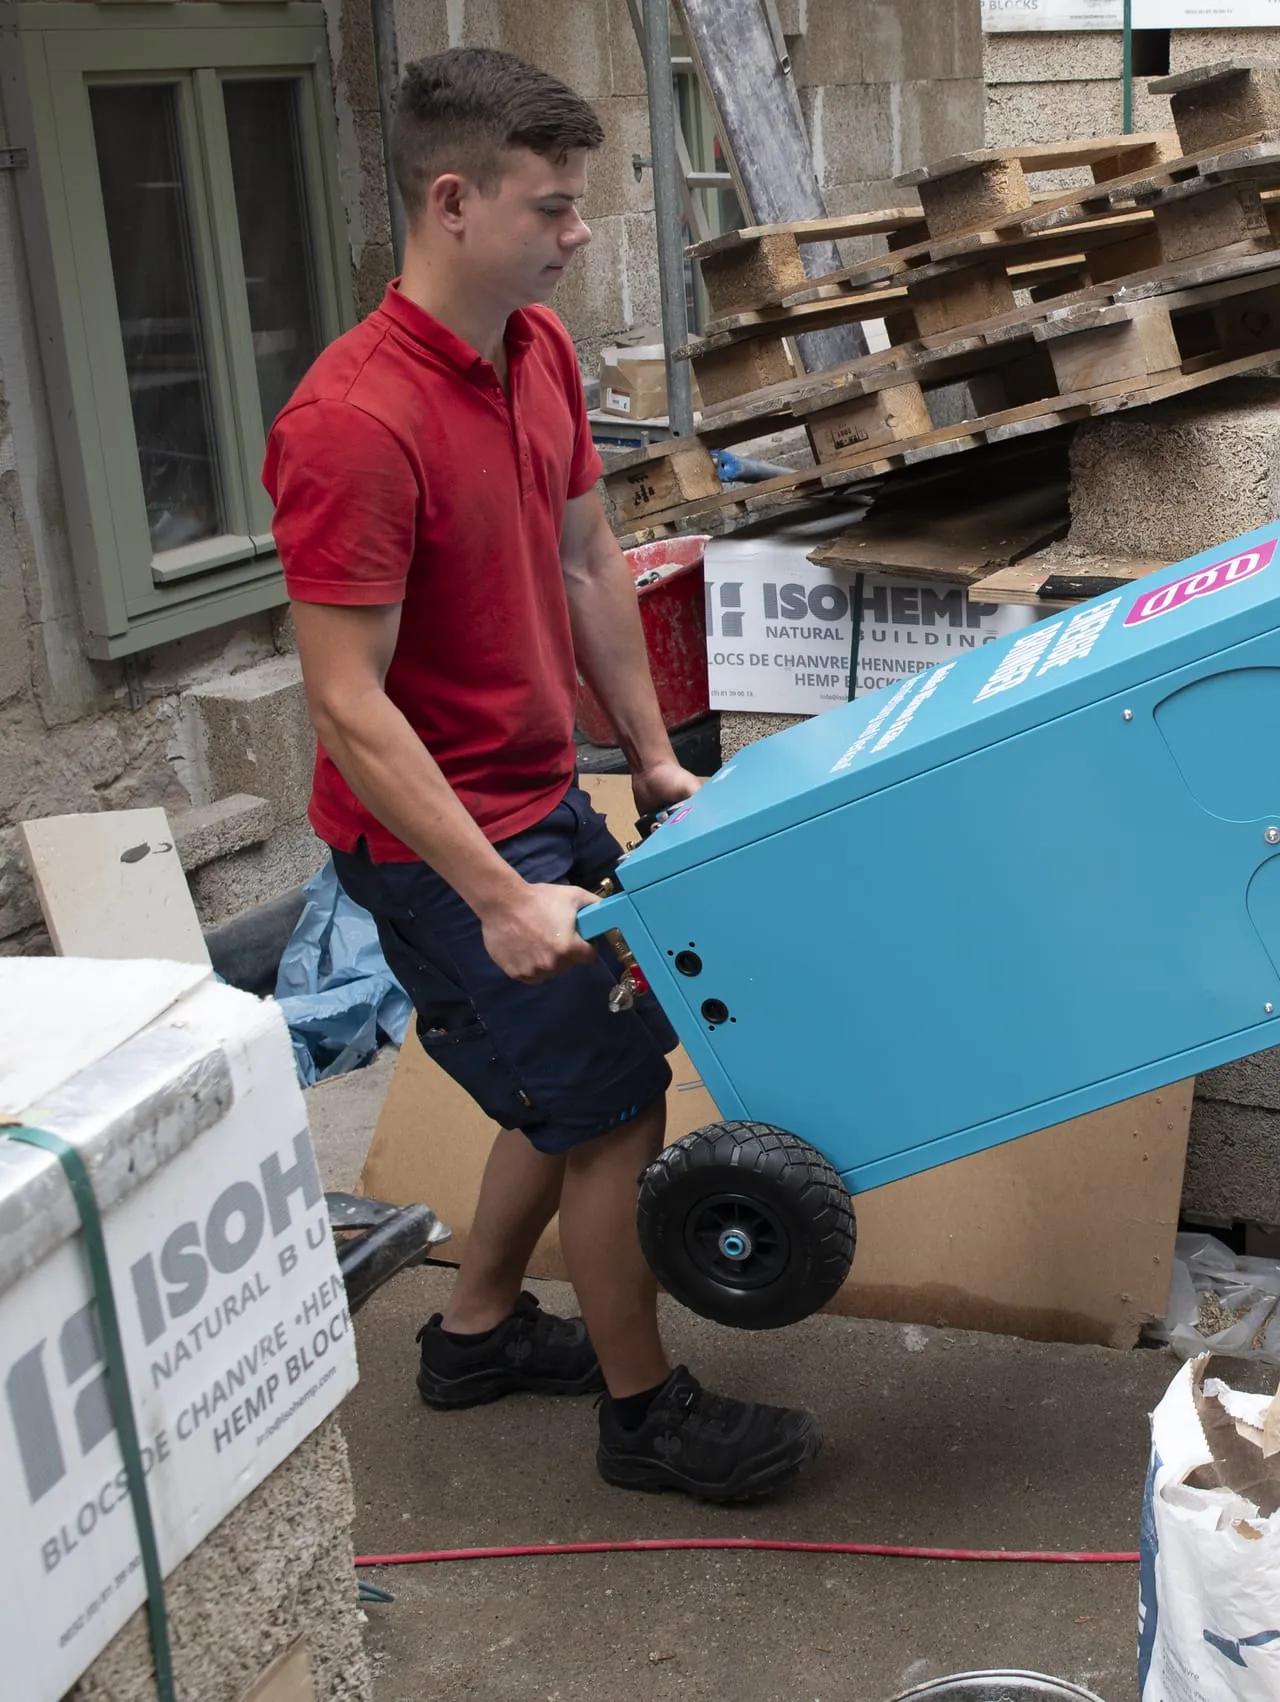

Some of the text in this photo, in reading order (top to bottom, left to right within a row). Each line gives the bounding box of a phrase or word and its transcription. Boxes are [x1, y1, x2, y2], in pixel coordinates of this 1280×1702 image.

[762, 583, 999, 628] ISOHEMP
[765, 626, 844, 640] NATURAL
[750, 653, 769, 666] DE
[774, 654, 849, 669] CHANVRE
[795, 673, 839, 688] HEMP
[149, 1272, 271, 1390] NATURAL
[175, 1321, 288, 1442] CHANVRE
[212, 1374, 280, 1453] HEMP
